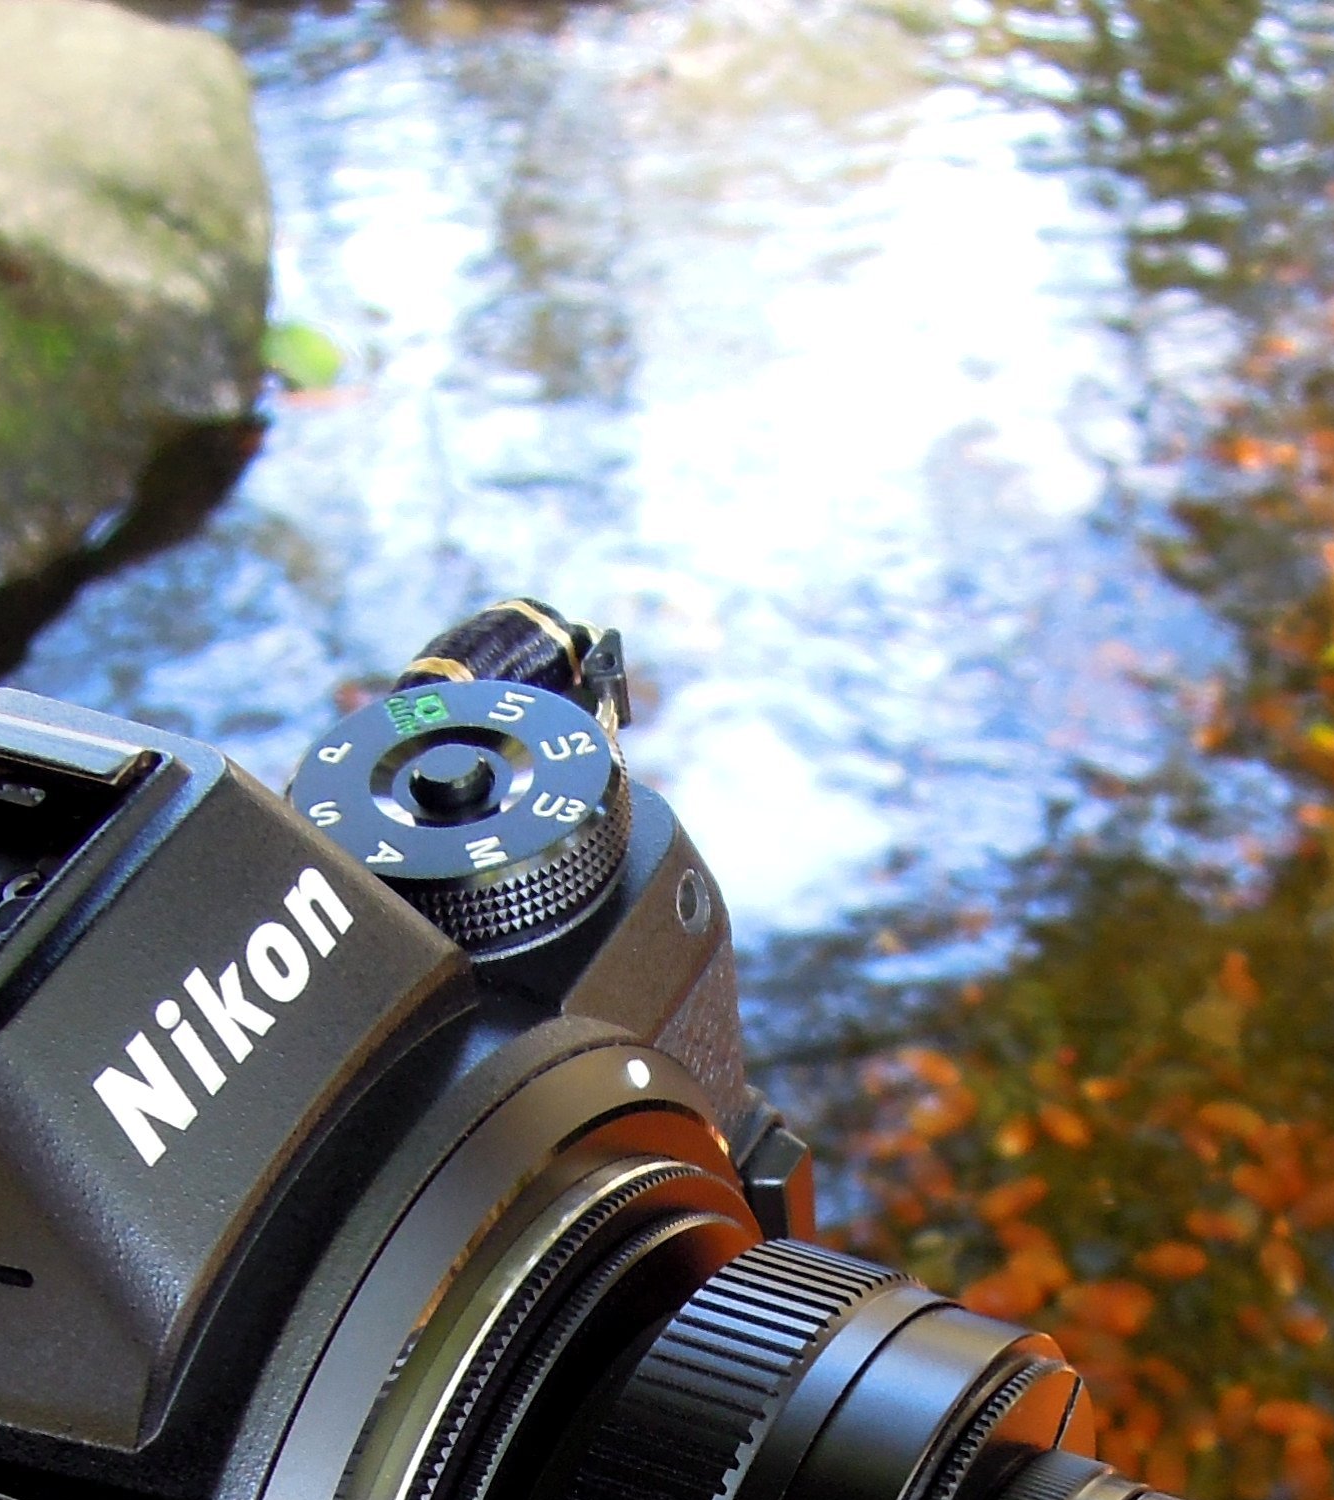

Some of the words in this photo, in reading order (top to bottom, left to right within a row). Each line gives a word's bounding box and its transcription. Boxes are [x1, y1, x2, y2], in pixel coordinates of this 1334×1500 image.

[488, 691, 536, 722] U1
[318, 741, 353, 764] P
[539, 731, 598, 761] U2
[308, 801, 342, 827] S
[531, 791, 587, 823] U3
[365, 841, 405, 864] A
[465, 835, 509, 869] M
[92, 866, 354, 1167] Nikon
